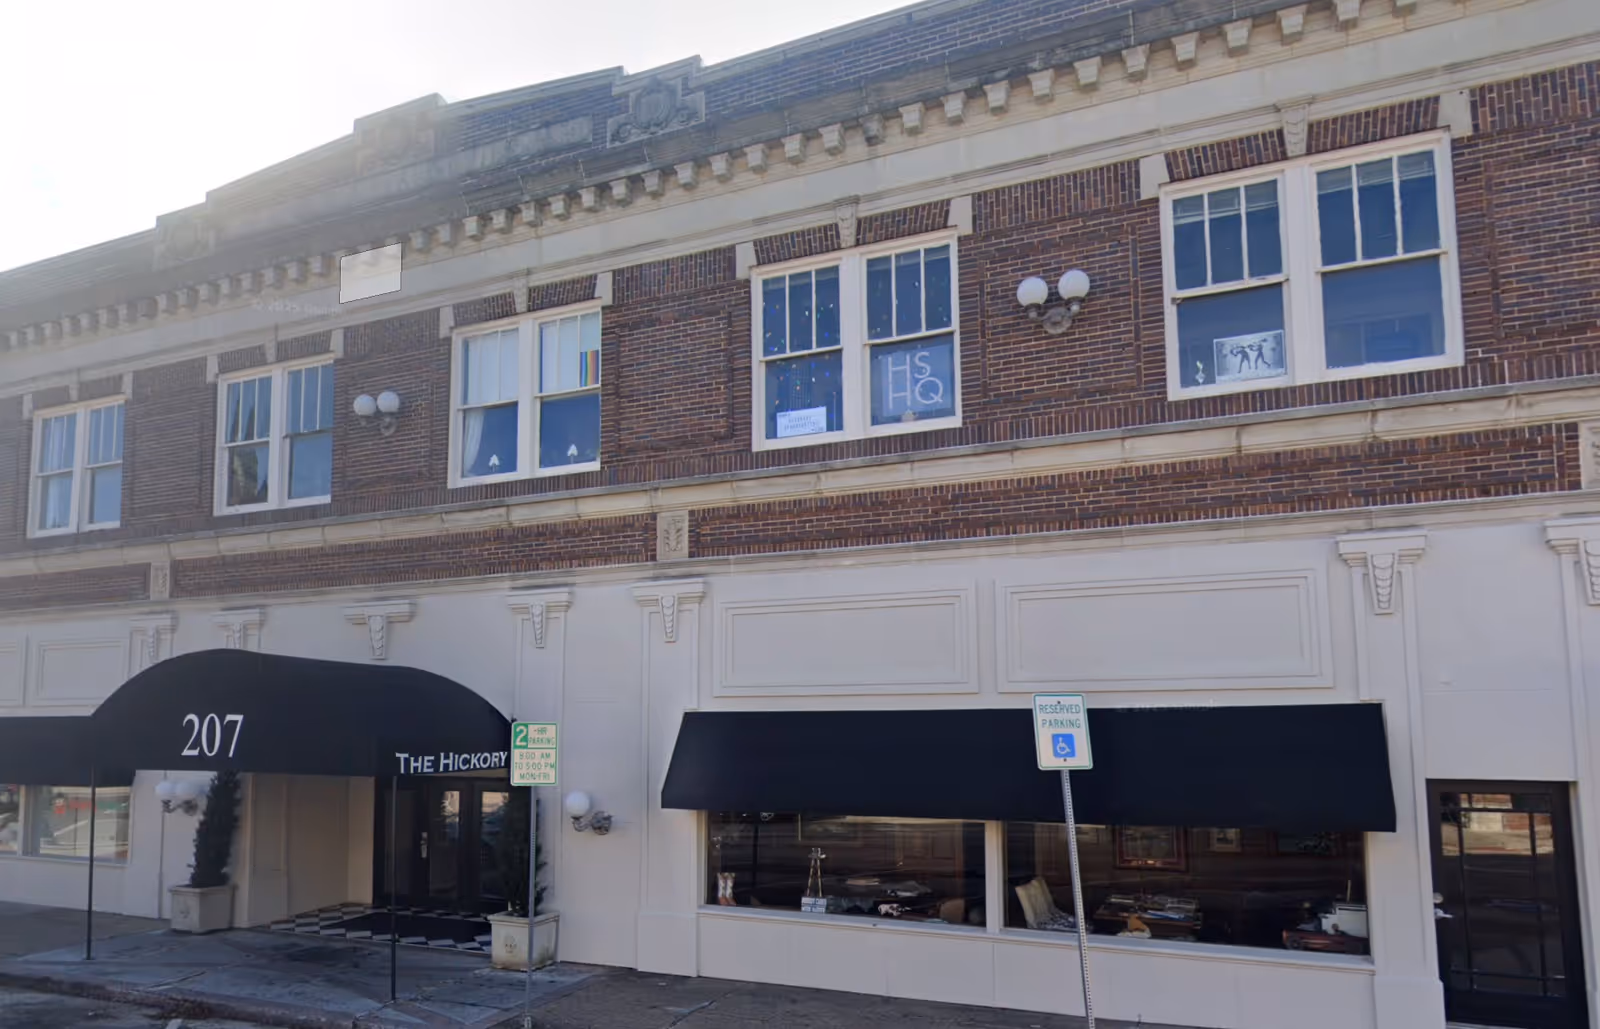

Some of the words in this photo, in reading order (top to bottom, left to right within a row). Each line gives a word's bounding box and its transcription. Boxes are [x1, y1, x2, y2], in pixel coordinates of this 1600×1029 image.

[1038, 704, 1081, 714] RESERVED
[1041, 718, 1081, 729] PARKING
[181, 713, 244, 758] 207
[515, 725, 528, 746] 2
[528, 737, 555, 746] PARKING
[540, 752, 551, 760] AM
[514, 762, 524, 770] TO
